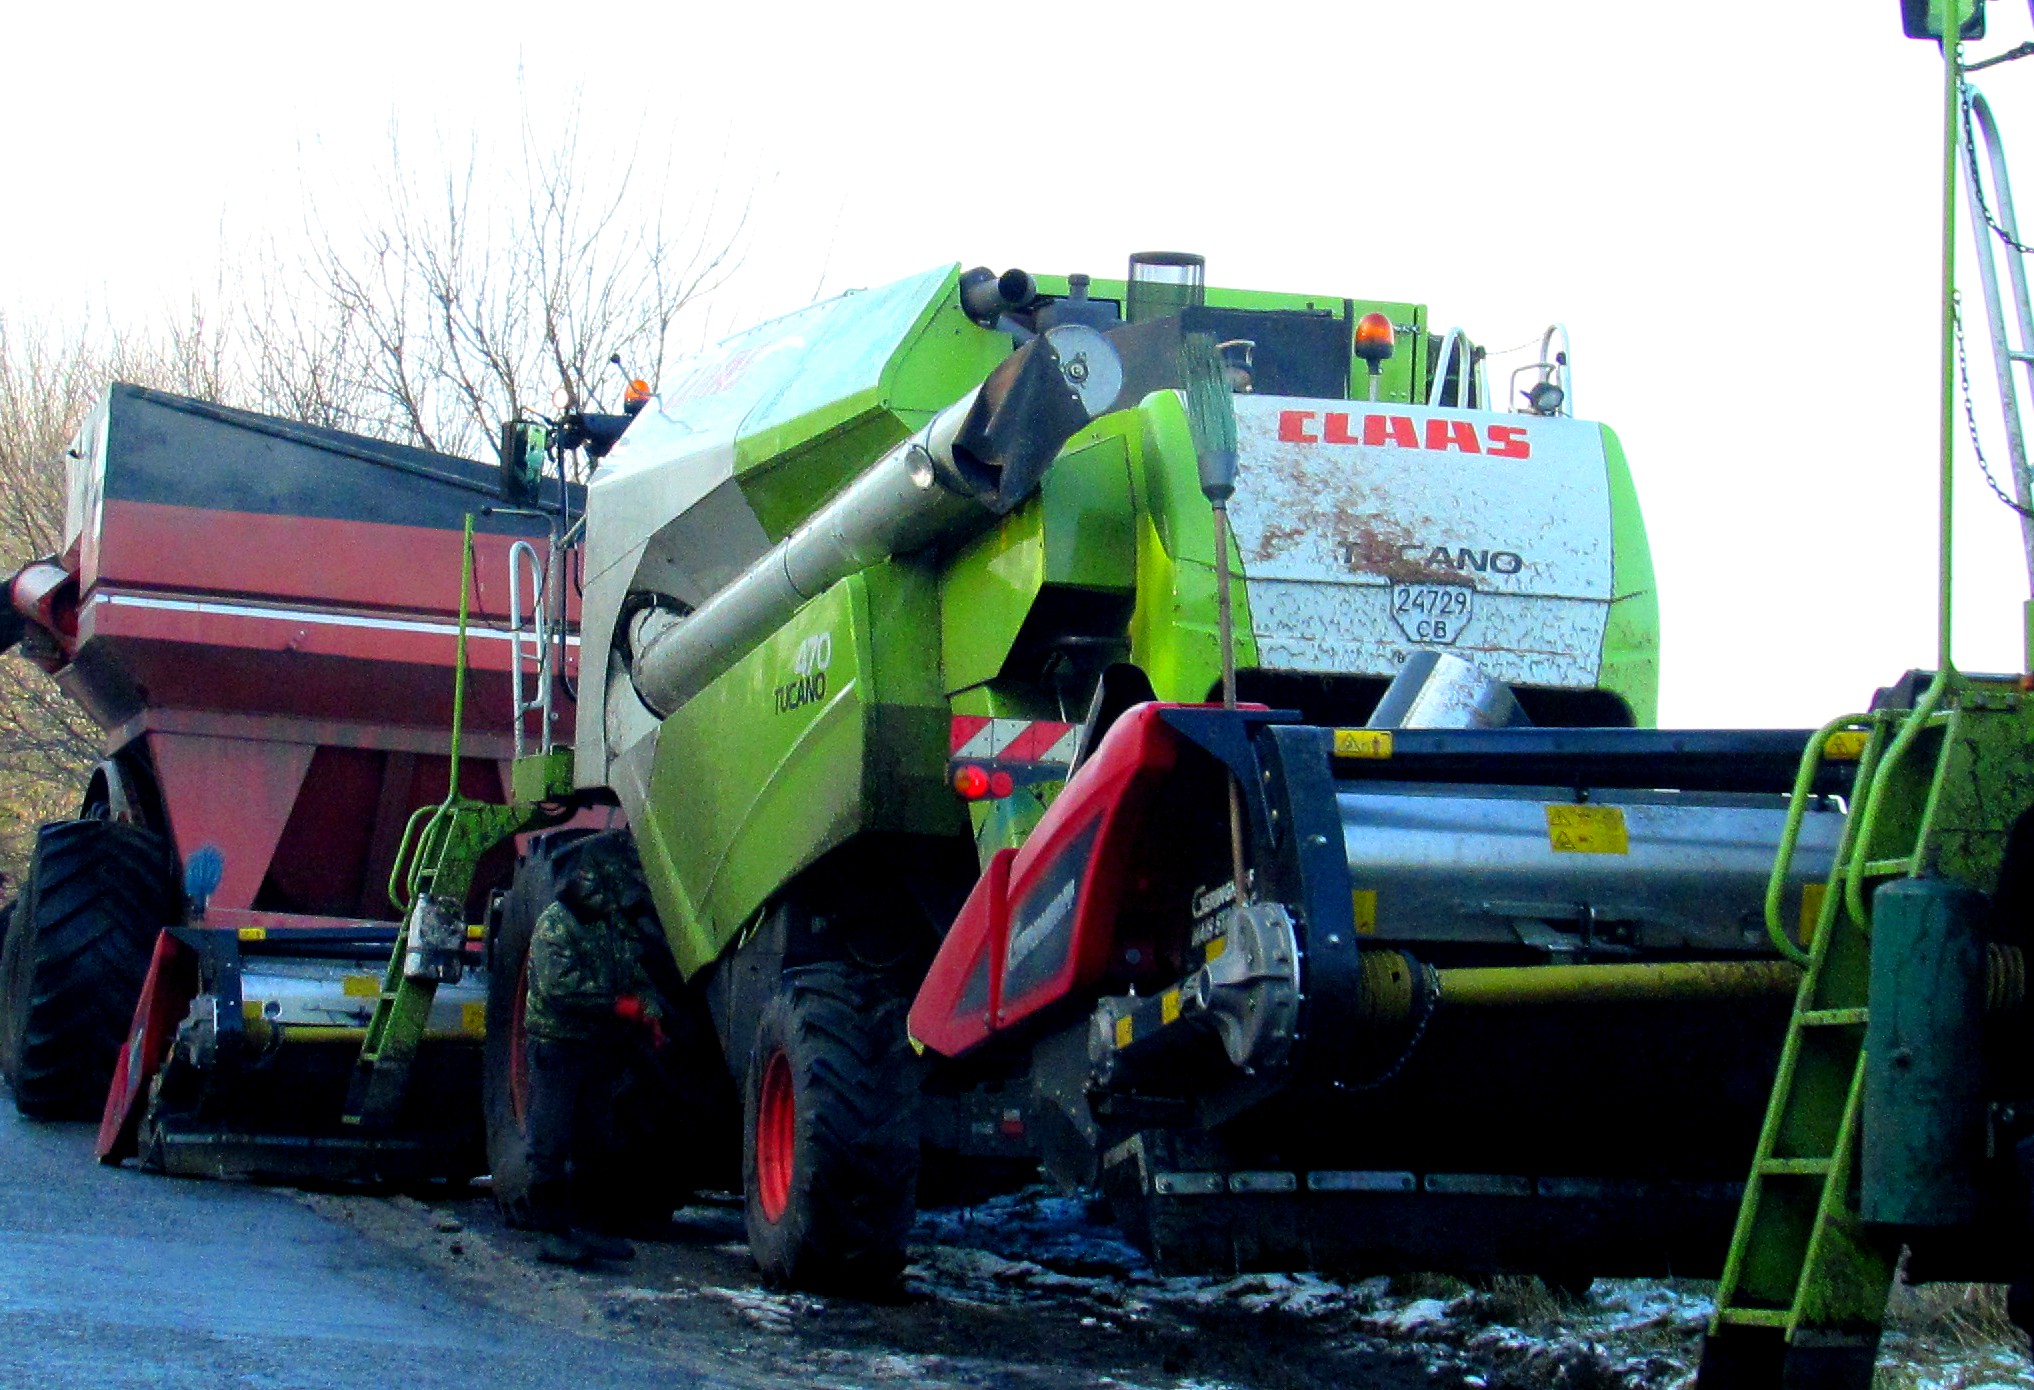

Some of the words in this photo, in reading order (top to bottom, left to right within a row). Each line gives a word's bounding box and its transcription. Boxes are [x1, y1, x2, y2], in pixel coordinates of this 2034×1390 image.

[1278, 410, 1530, 459] CLAAS
[1338, 541, 1523, 574] TANO
[1396, 588, 1467, 615] 24729
[1416, 620, 1448, 639] CB
[794, 631, 832, 675] 470
[774, 672, 827, 716] TUCANO
